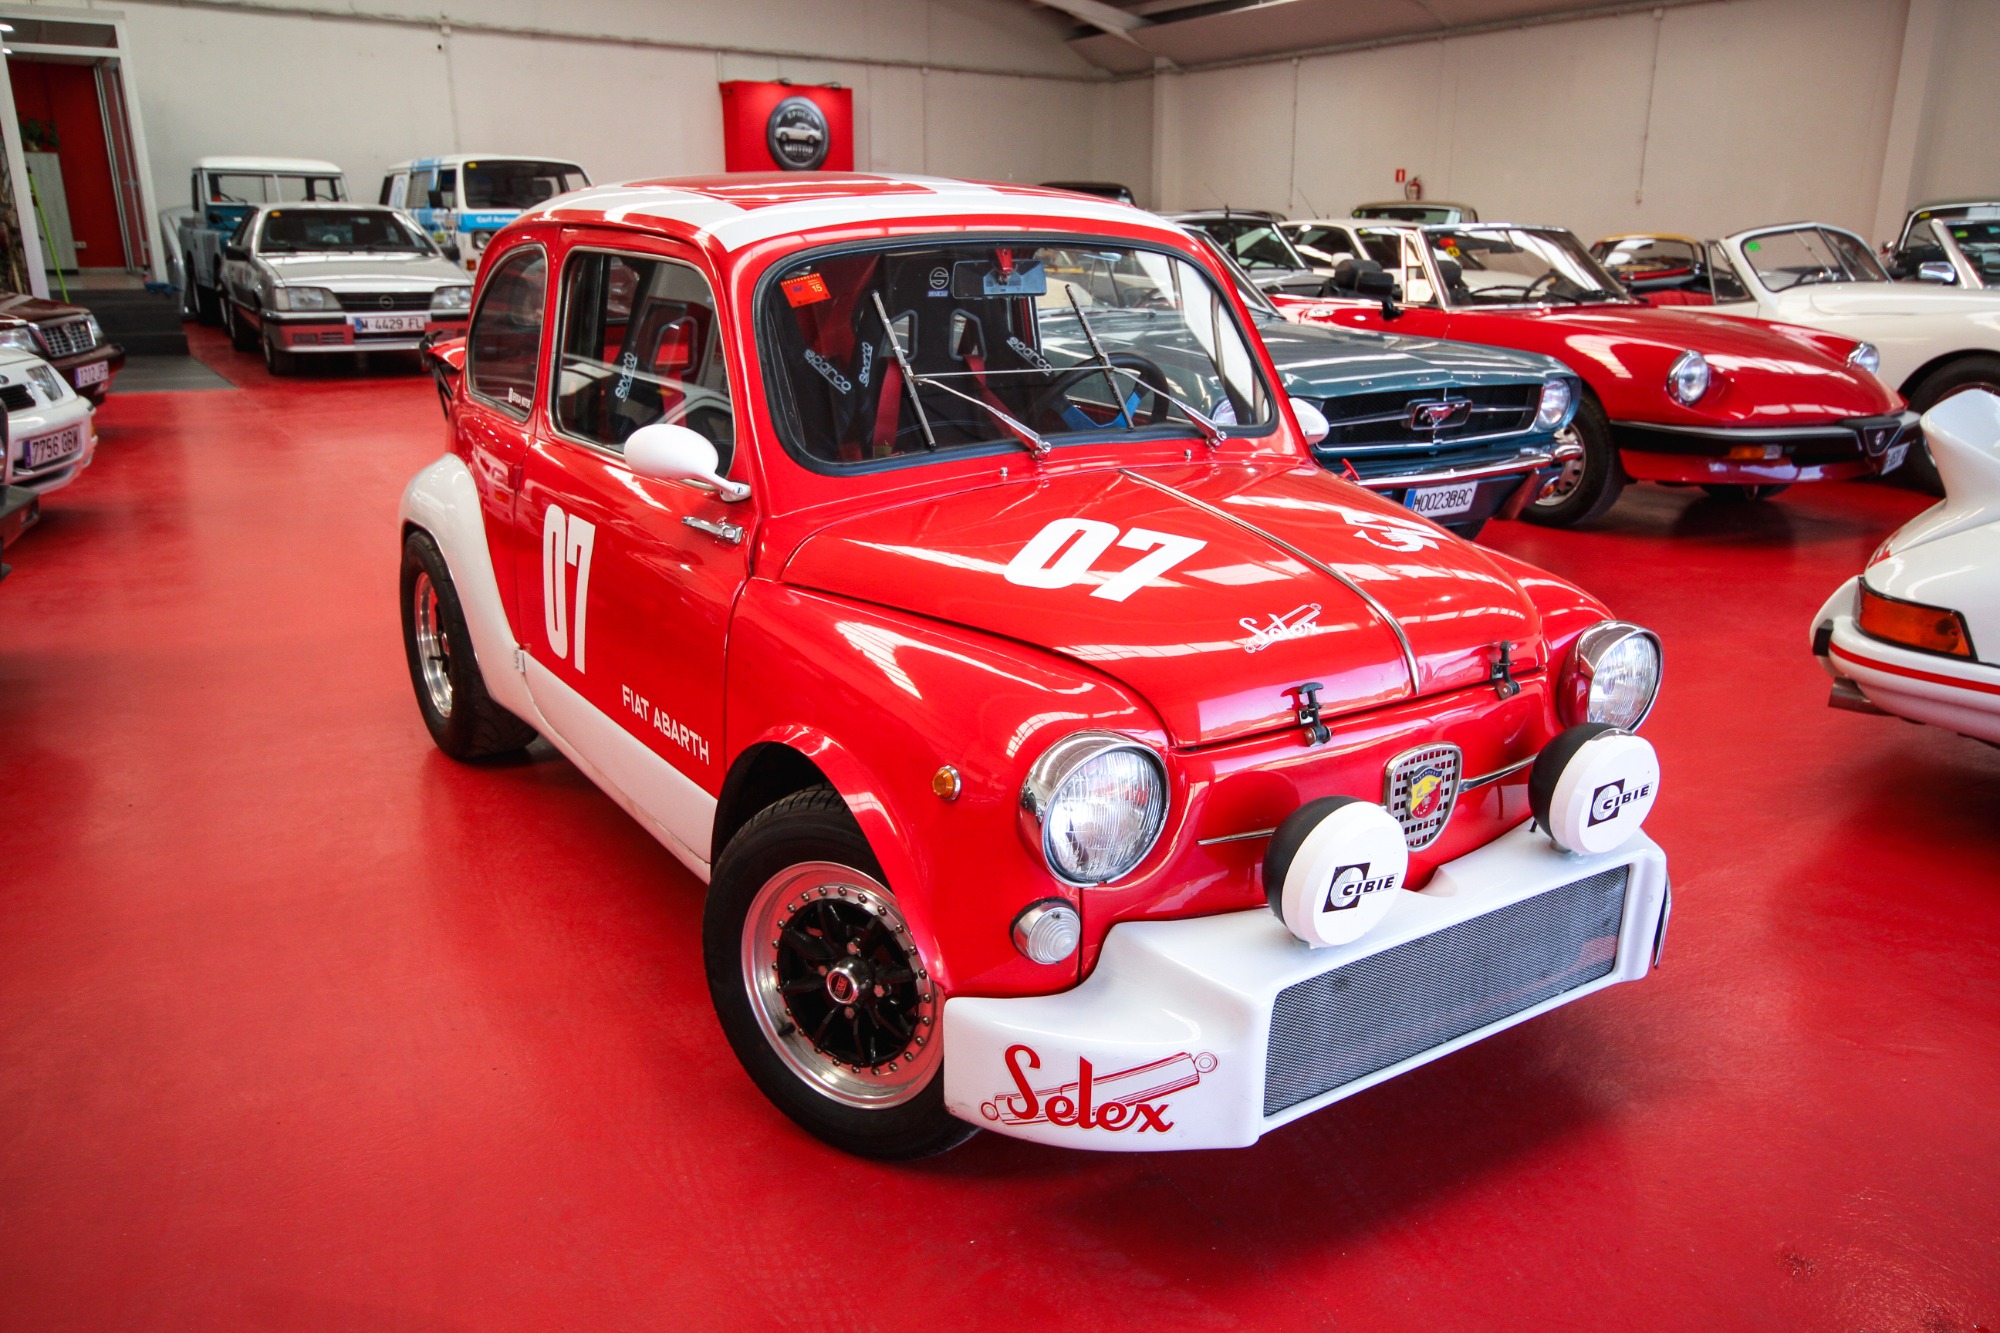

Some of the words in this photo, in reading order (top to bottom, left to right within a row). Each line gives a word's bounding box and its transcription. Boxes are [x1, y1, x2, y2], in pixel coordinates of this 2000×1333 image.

[784, 145, 814, 154] MOTOR
[811, 284, 823, 293] 15
[375, 318, 403, 330] 4429
[408, 317, 423, 329] FL
[614, 351, 638, 402] sparco
[803, 348, 852, 395] sparco
[1005, 335, 1053, 377] sparco
[32, 436, 59, 464] 7756
[61, 427, 79, 453] GBW
[1003, 517, 1208, 602] 07
[543, 503, 596, 676] 07
[622, 684, 650, 722] FIAT
[653, 707, 710, 766] ABARTH
[1602, 785, 1650, 810] CIBIE
[1342, 876, 1395, 897] CIBIE
[1004, 1043, 1175, 1133] Selex
